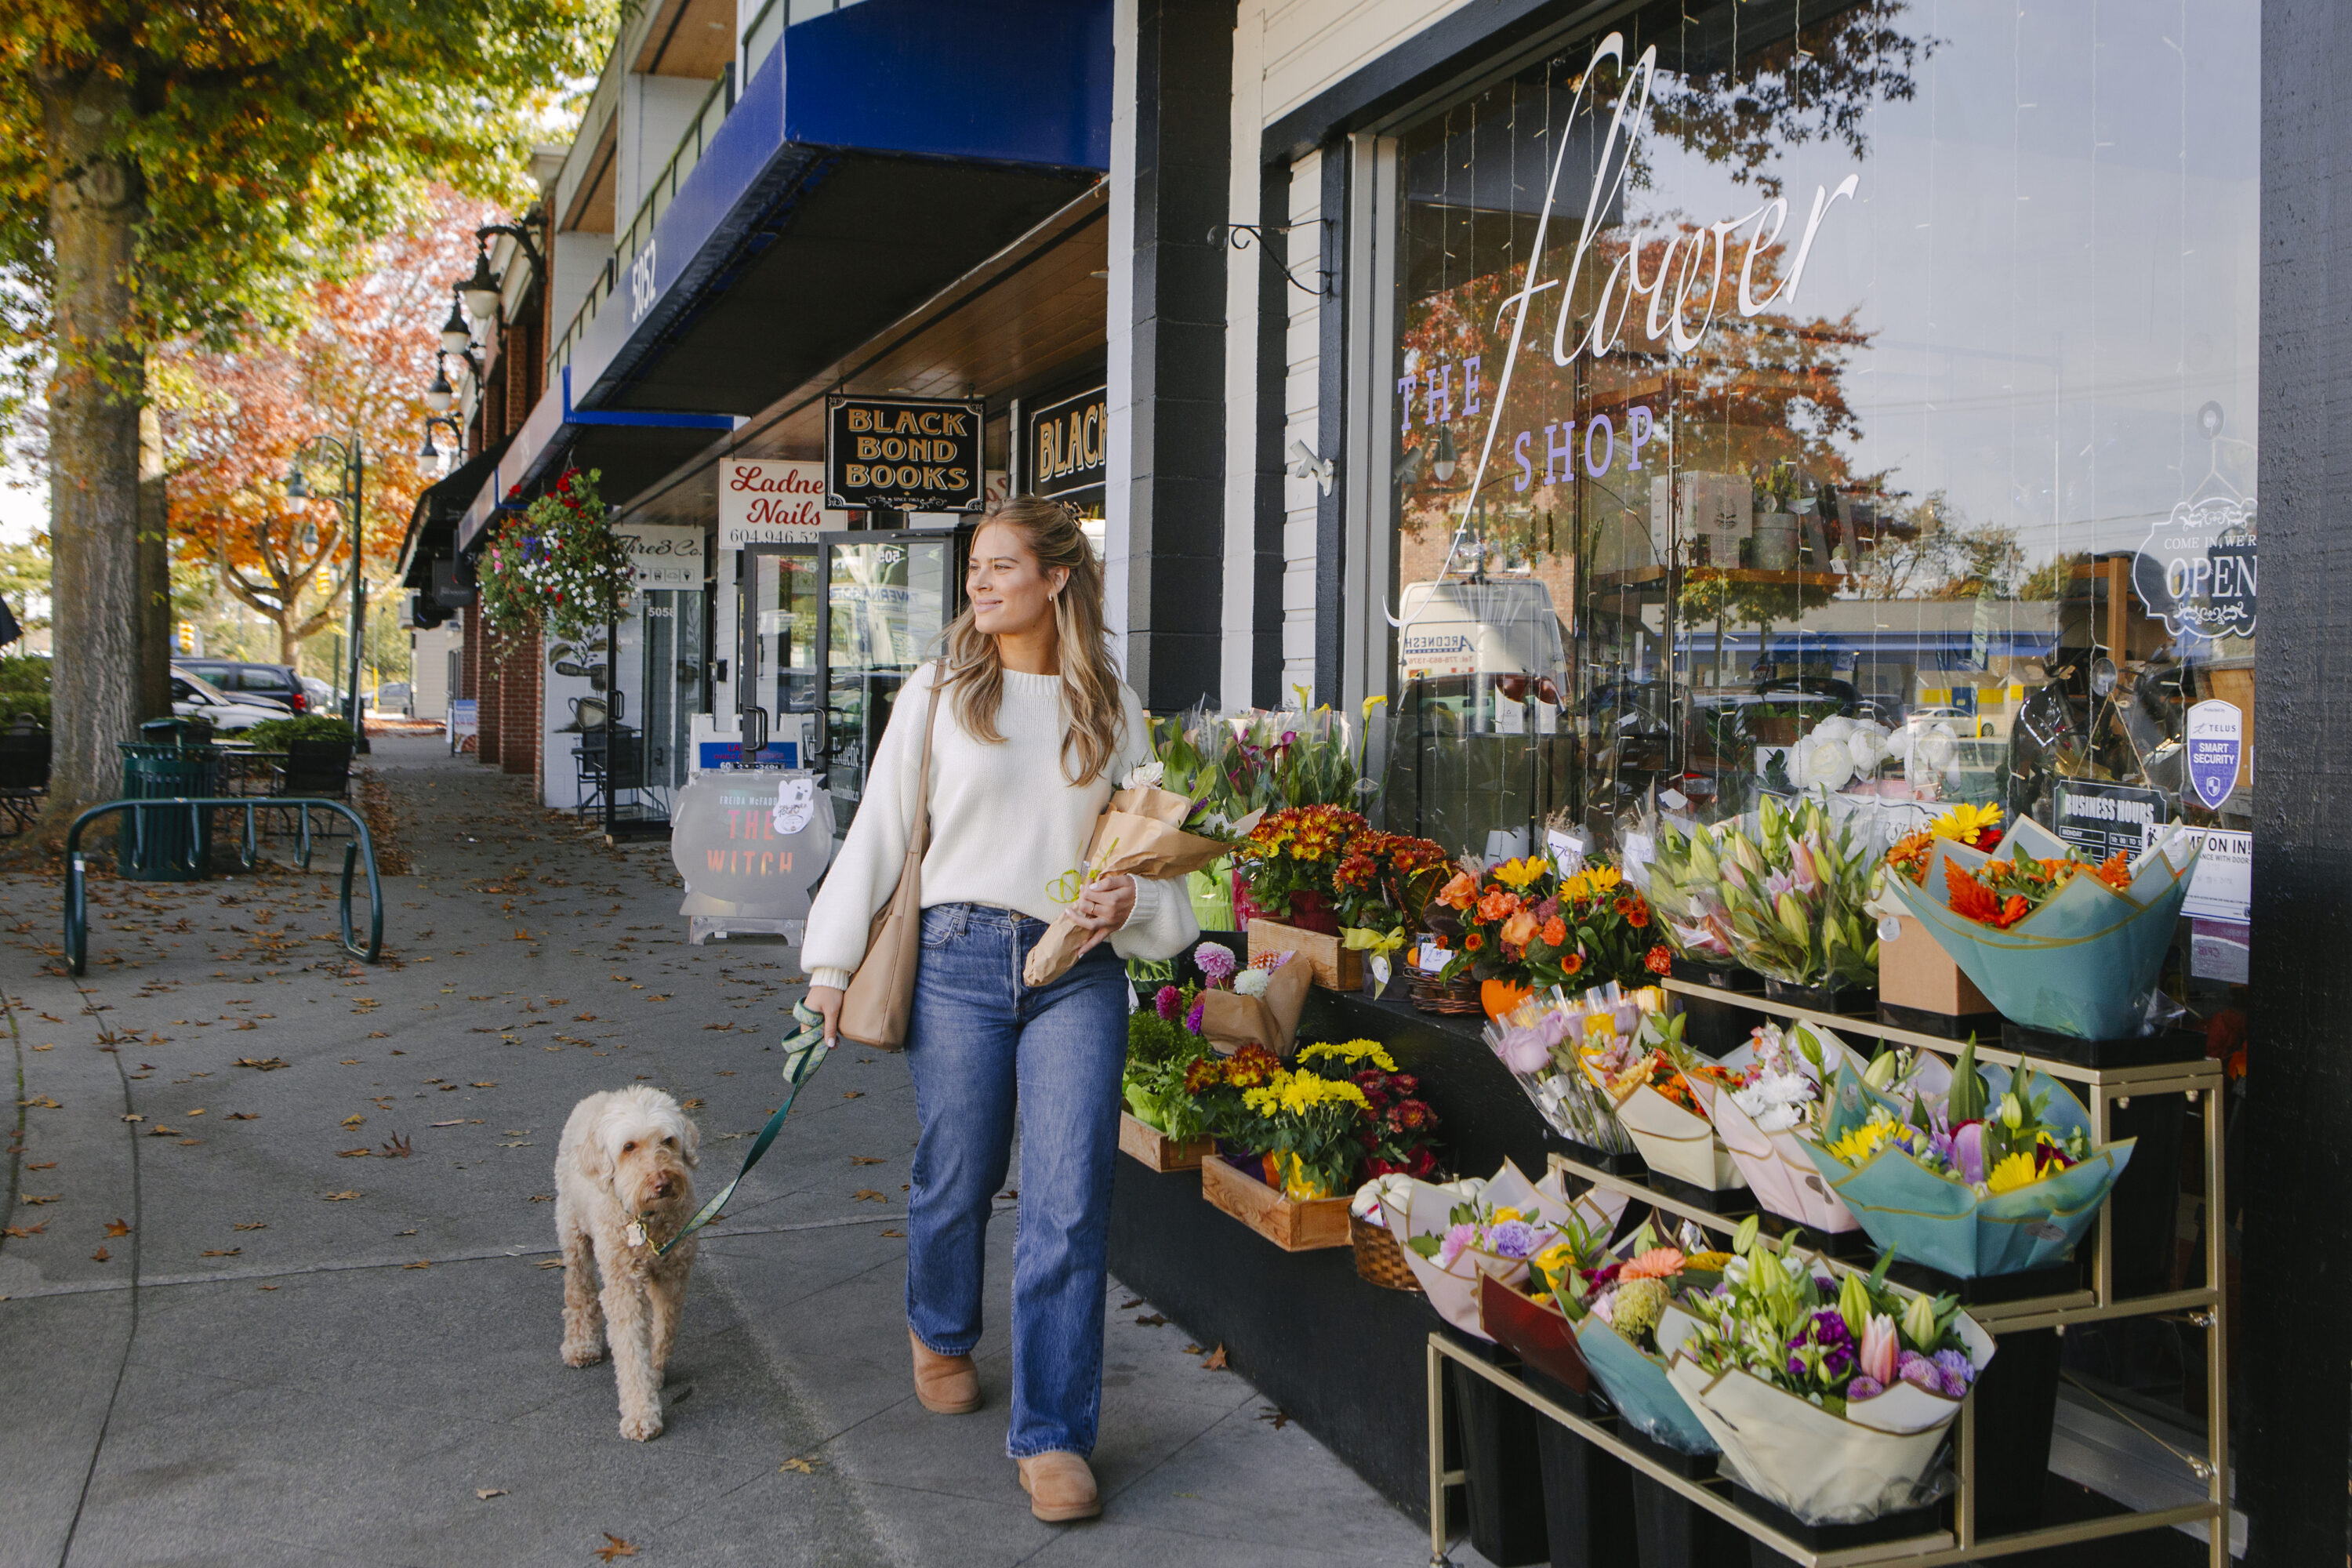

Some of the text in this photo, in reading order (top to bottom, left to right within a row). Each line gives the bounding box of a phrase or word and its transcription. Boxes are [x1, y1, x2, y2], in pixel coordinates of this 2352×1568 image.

[632, 238, 656, 324] 5052
[1383, 31, 1861, 628] flower
[1397, 355, 1483, 432] THE
[848, 408, 968, 437] BLACK
[856, 436, 958, 463] BOND
[1513, 405, 1654, 493] SHOP
[730, 466, 825, 494] Ladne
[845, 463, 970, 491] BOOKS
[746, 498, 821, 526] Nails
[673, 539, 702, 557] Co.
[730, 528, 818, 543] 604.946.52
[2164, 536, 2200, 550] COME
[2224, 533, 2257, 547] WE'R
[2166, 555, 2257, 599] OPEN
[648, 606, 673, 618] 5058
[2193, 753, 2235, 765] SECURITY
[2198, 742, 2230, 753] SMART
[720, 796, 778, 807] FREIDA McFADD
[2064, 793, 2154, 824] BUSINESS HOURS
[728, 809, 775, 840] THE
[2061, 828, 2083, 837] MONDAY
[2208, 837, 2227, 853] ON
[2233, 839, 2252, 855] IN!
[707, 849, 793, 877] WITCH
